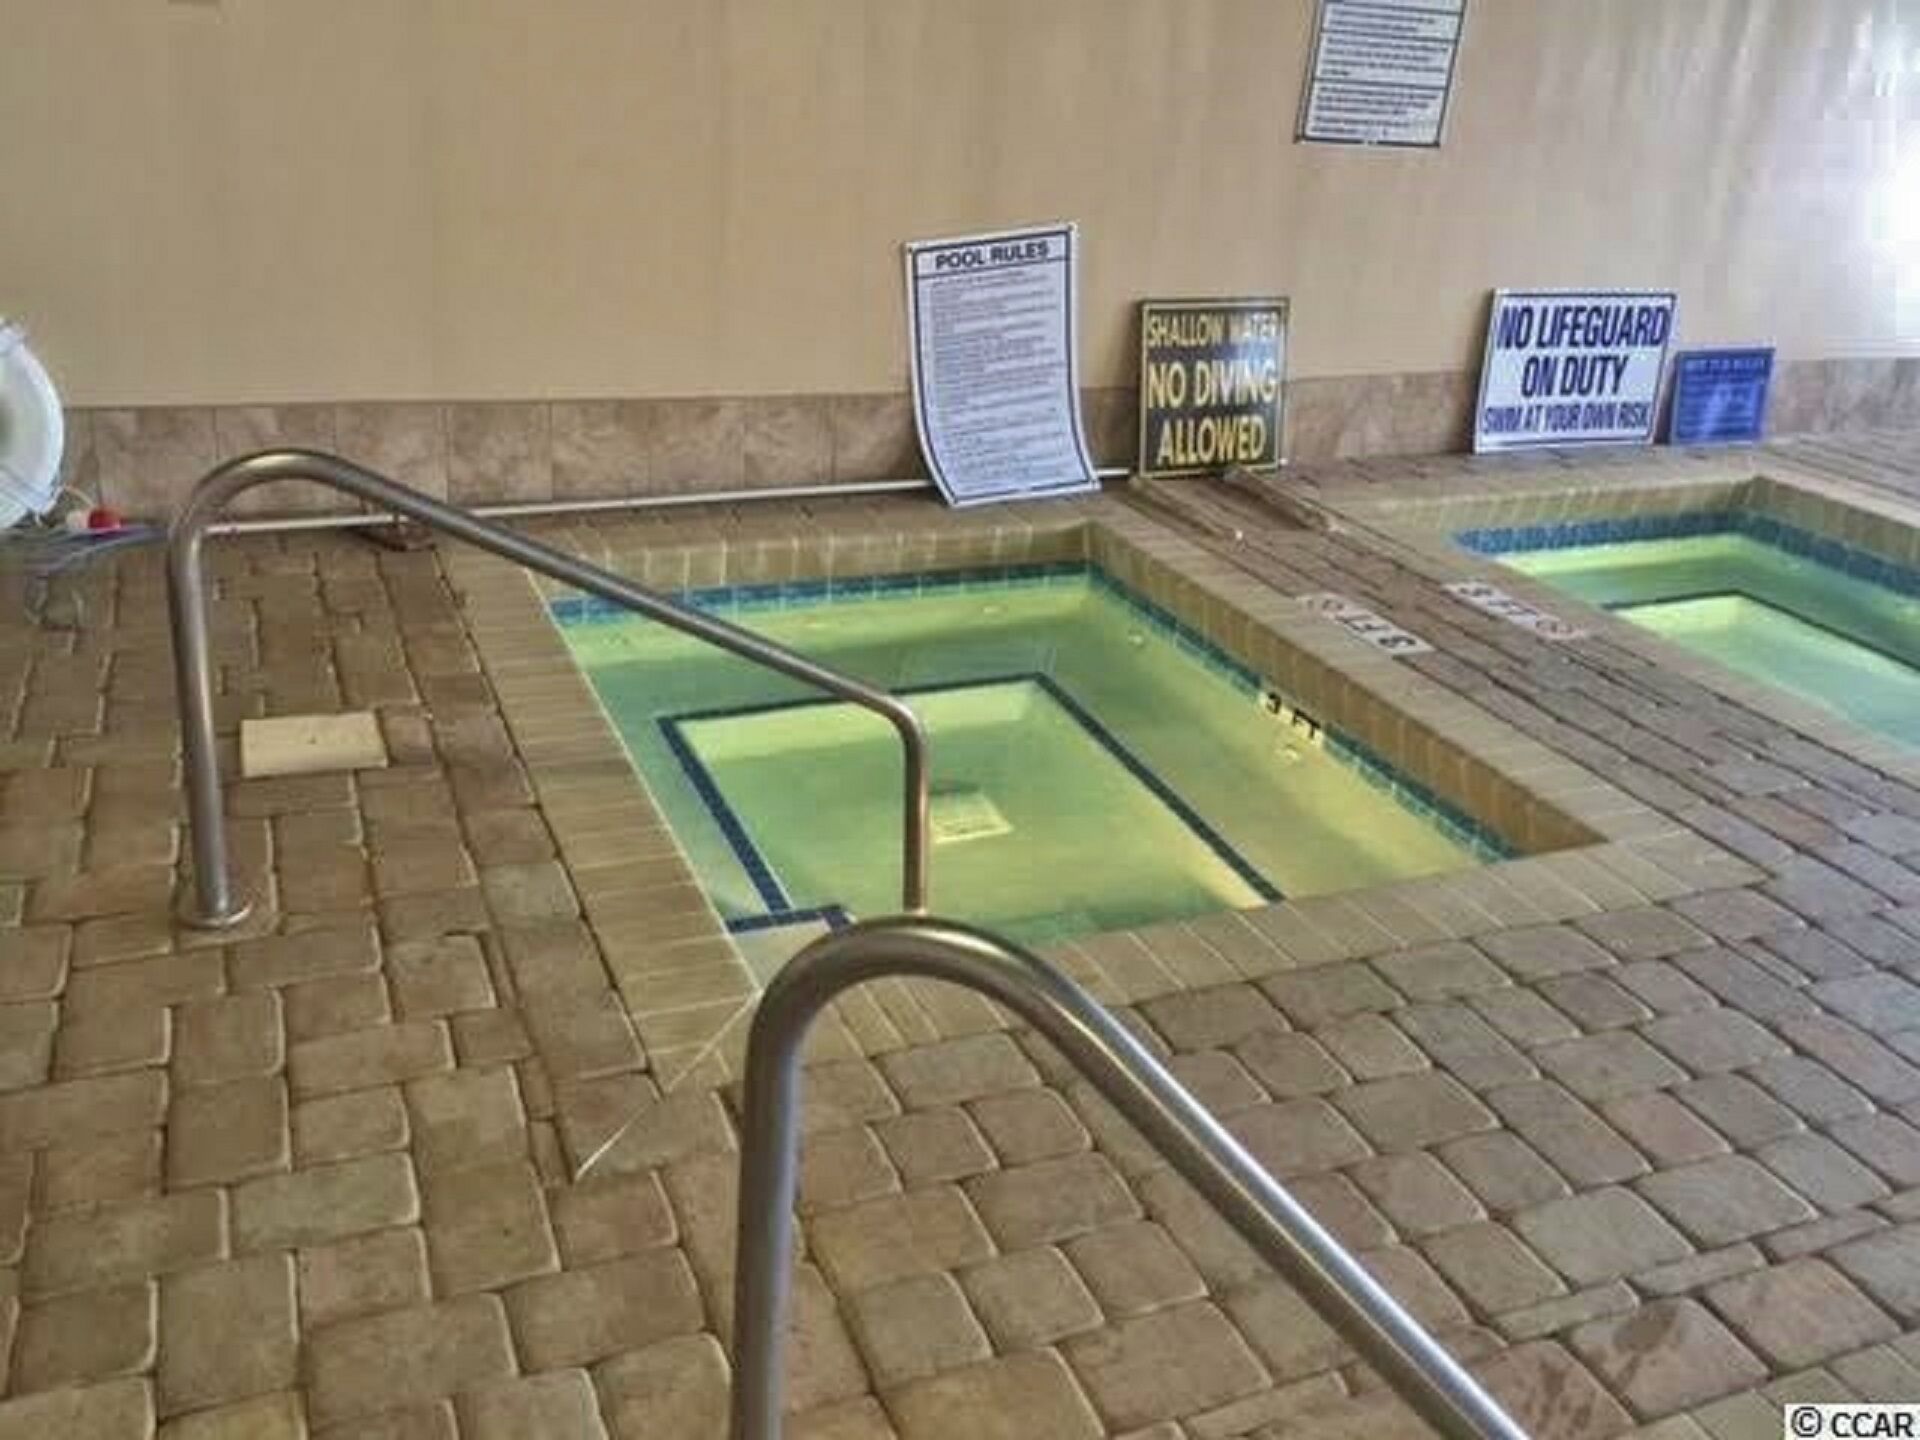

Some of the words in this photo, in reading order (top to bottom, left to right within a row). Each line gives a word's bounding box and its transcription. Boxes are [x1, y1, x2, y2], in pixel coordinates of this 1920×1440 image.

[935, 249, 985, 270] POOL
[990, 241, 1049, 262] RULES
[1148, 313, 1225, 347] SHALLOW
[1497, 305, 1533, 349] NO
[1535, 304, 1671, 348] LIFEGUARD
[1149, 361, 1187, 408] NO
[1194, 356, 1277, 407] DIVING
[1521, 356, 1558, 397] ON
[1560, 354, 1629, 396] DUTY
[1523, 405, 1544, 430] AT
[1157, 415, 1267, 465] ALLOWED
[1266, 691, 1282, 715] 3
[1292, 707, 1321, 740] FT
